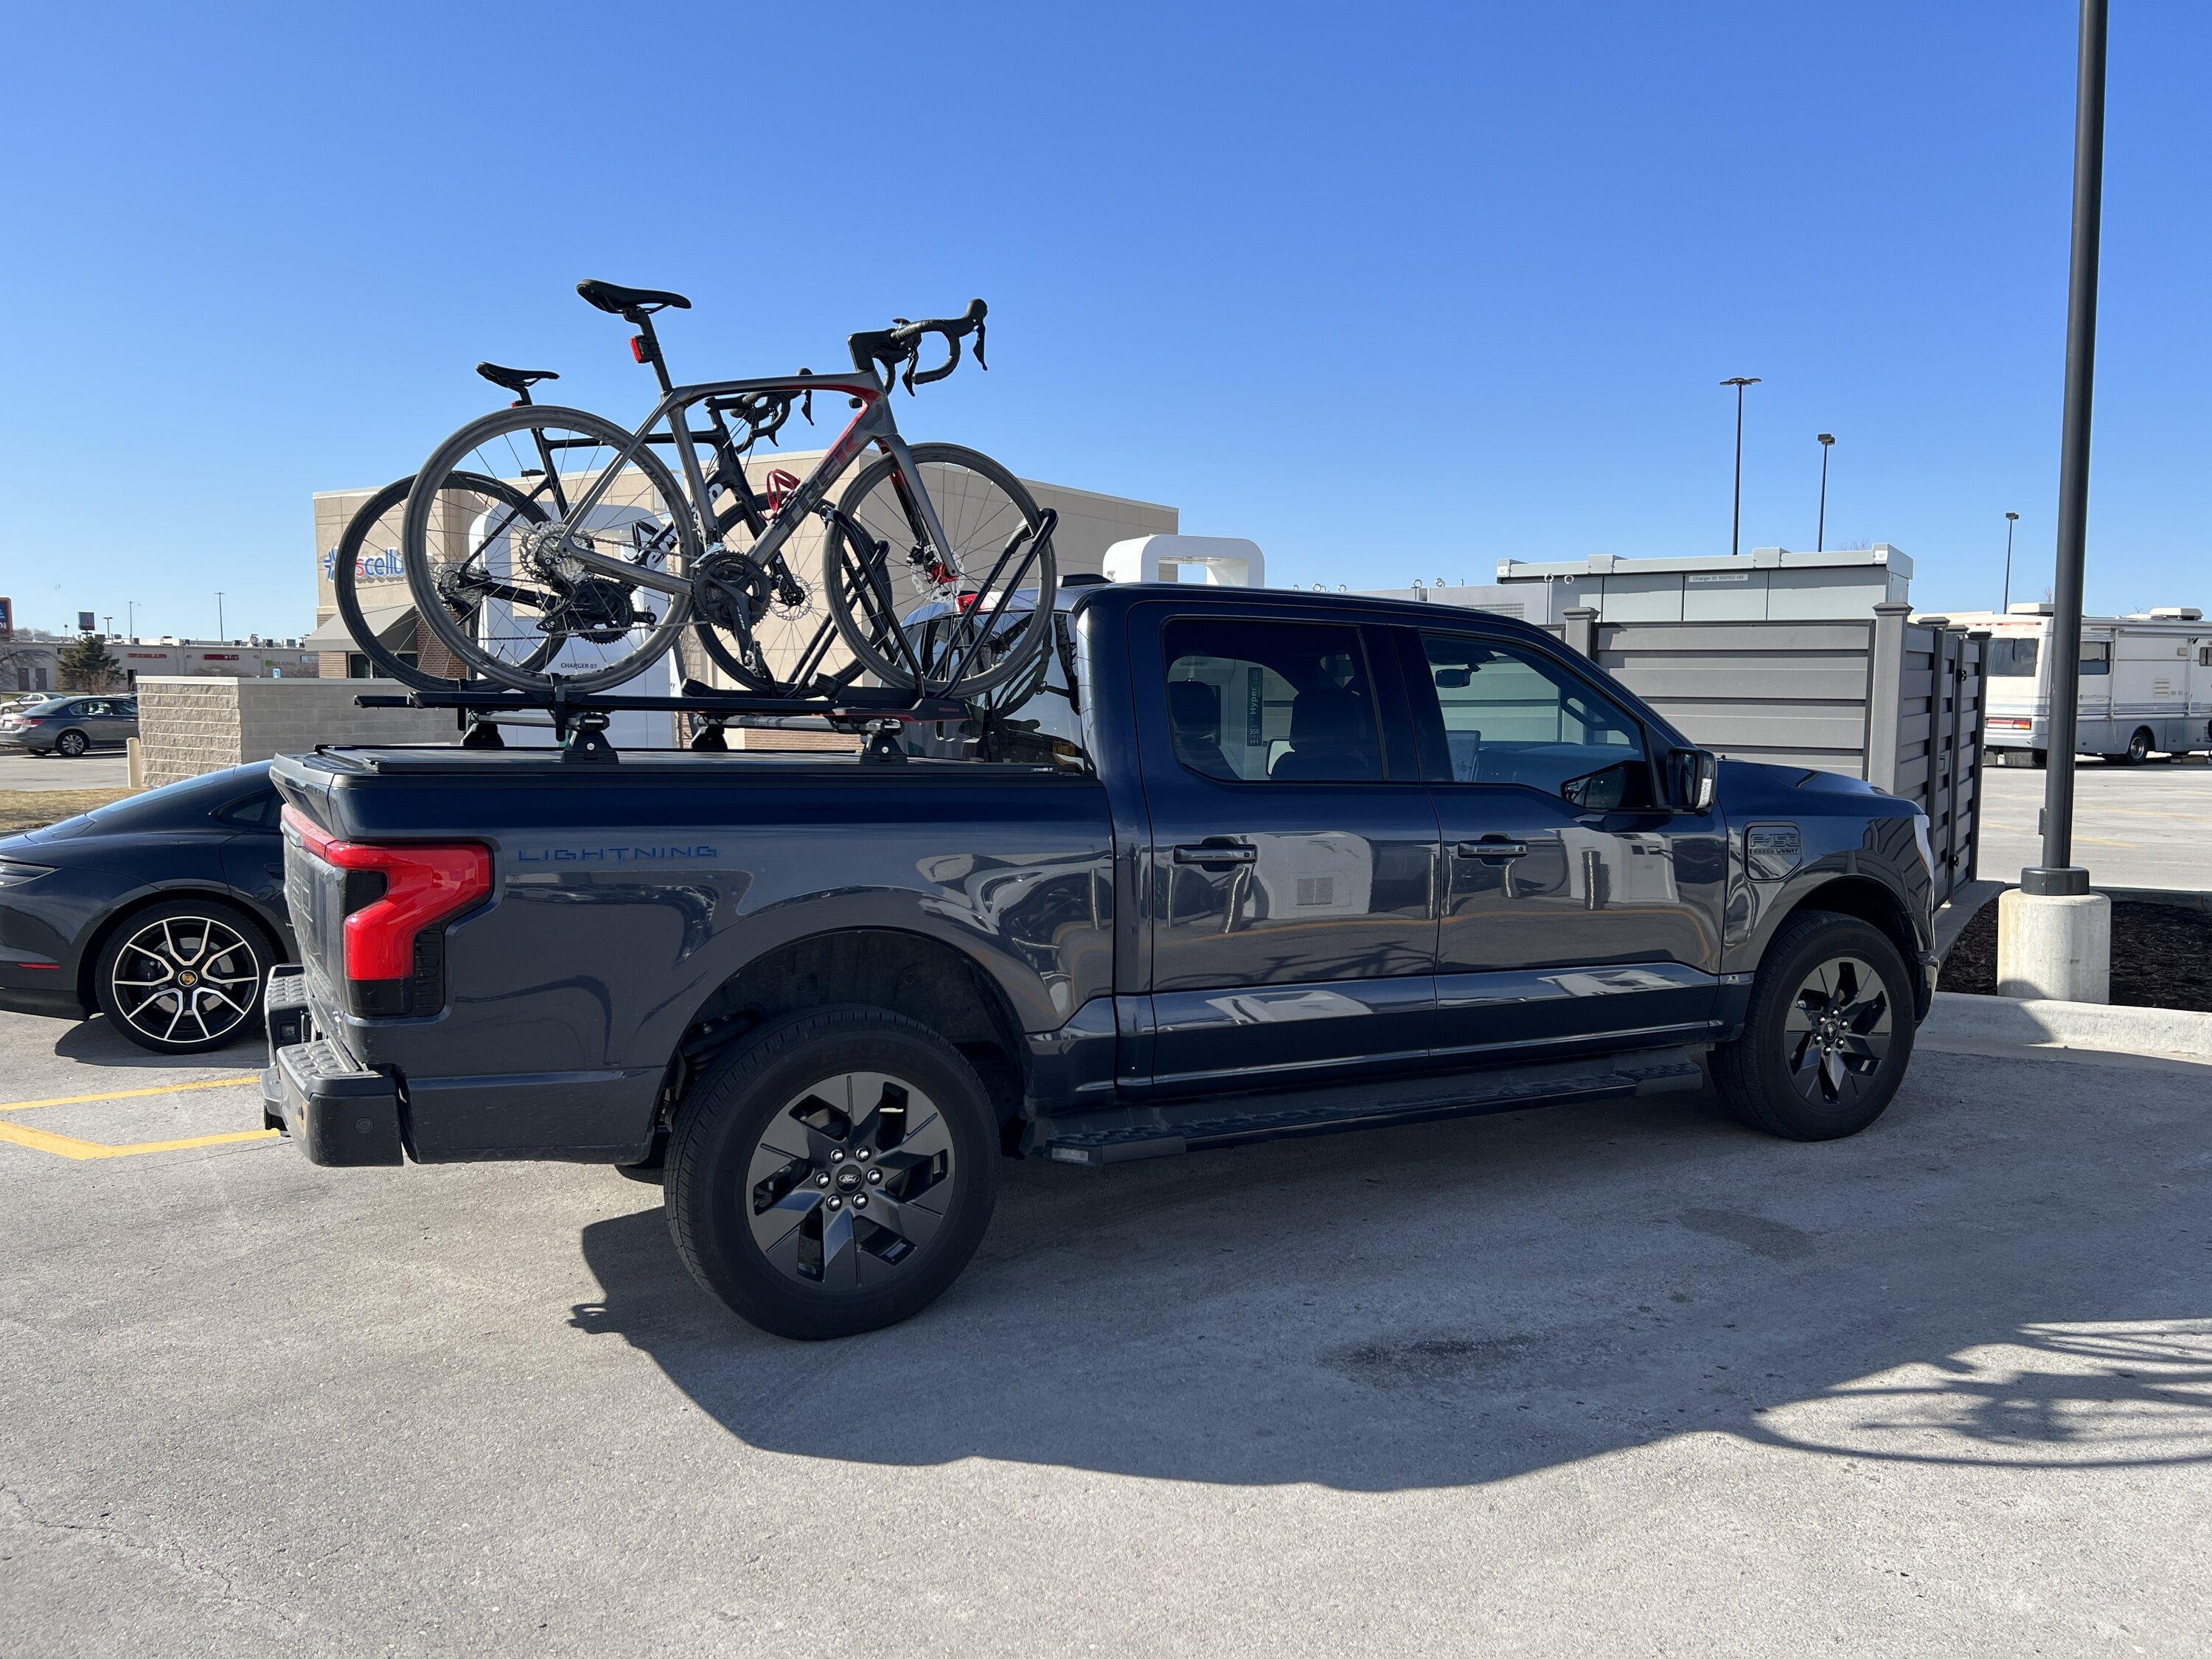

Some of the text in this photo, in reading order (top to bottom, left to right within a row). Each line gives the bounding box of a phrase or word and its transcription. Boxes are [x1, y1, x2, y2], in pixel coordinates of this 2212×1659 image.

[776, 434, 860, 530] TREK
[1250, 686, 1259, 714] Hyper
[1750, 833, 1800, 847] F-150
[518, 846, 720, 863] LIGHTNING
